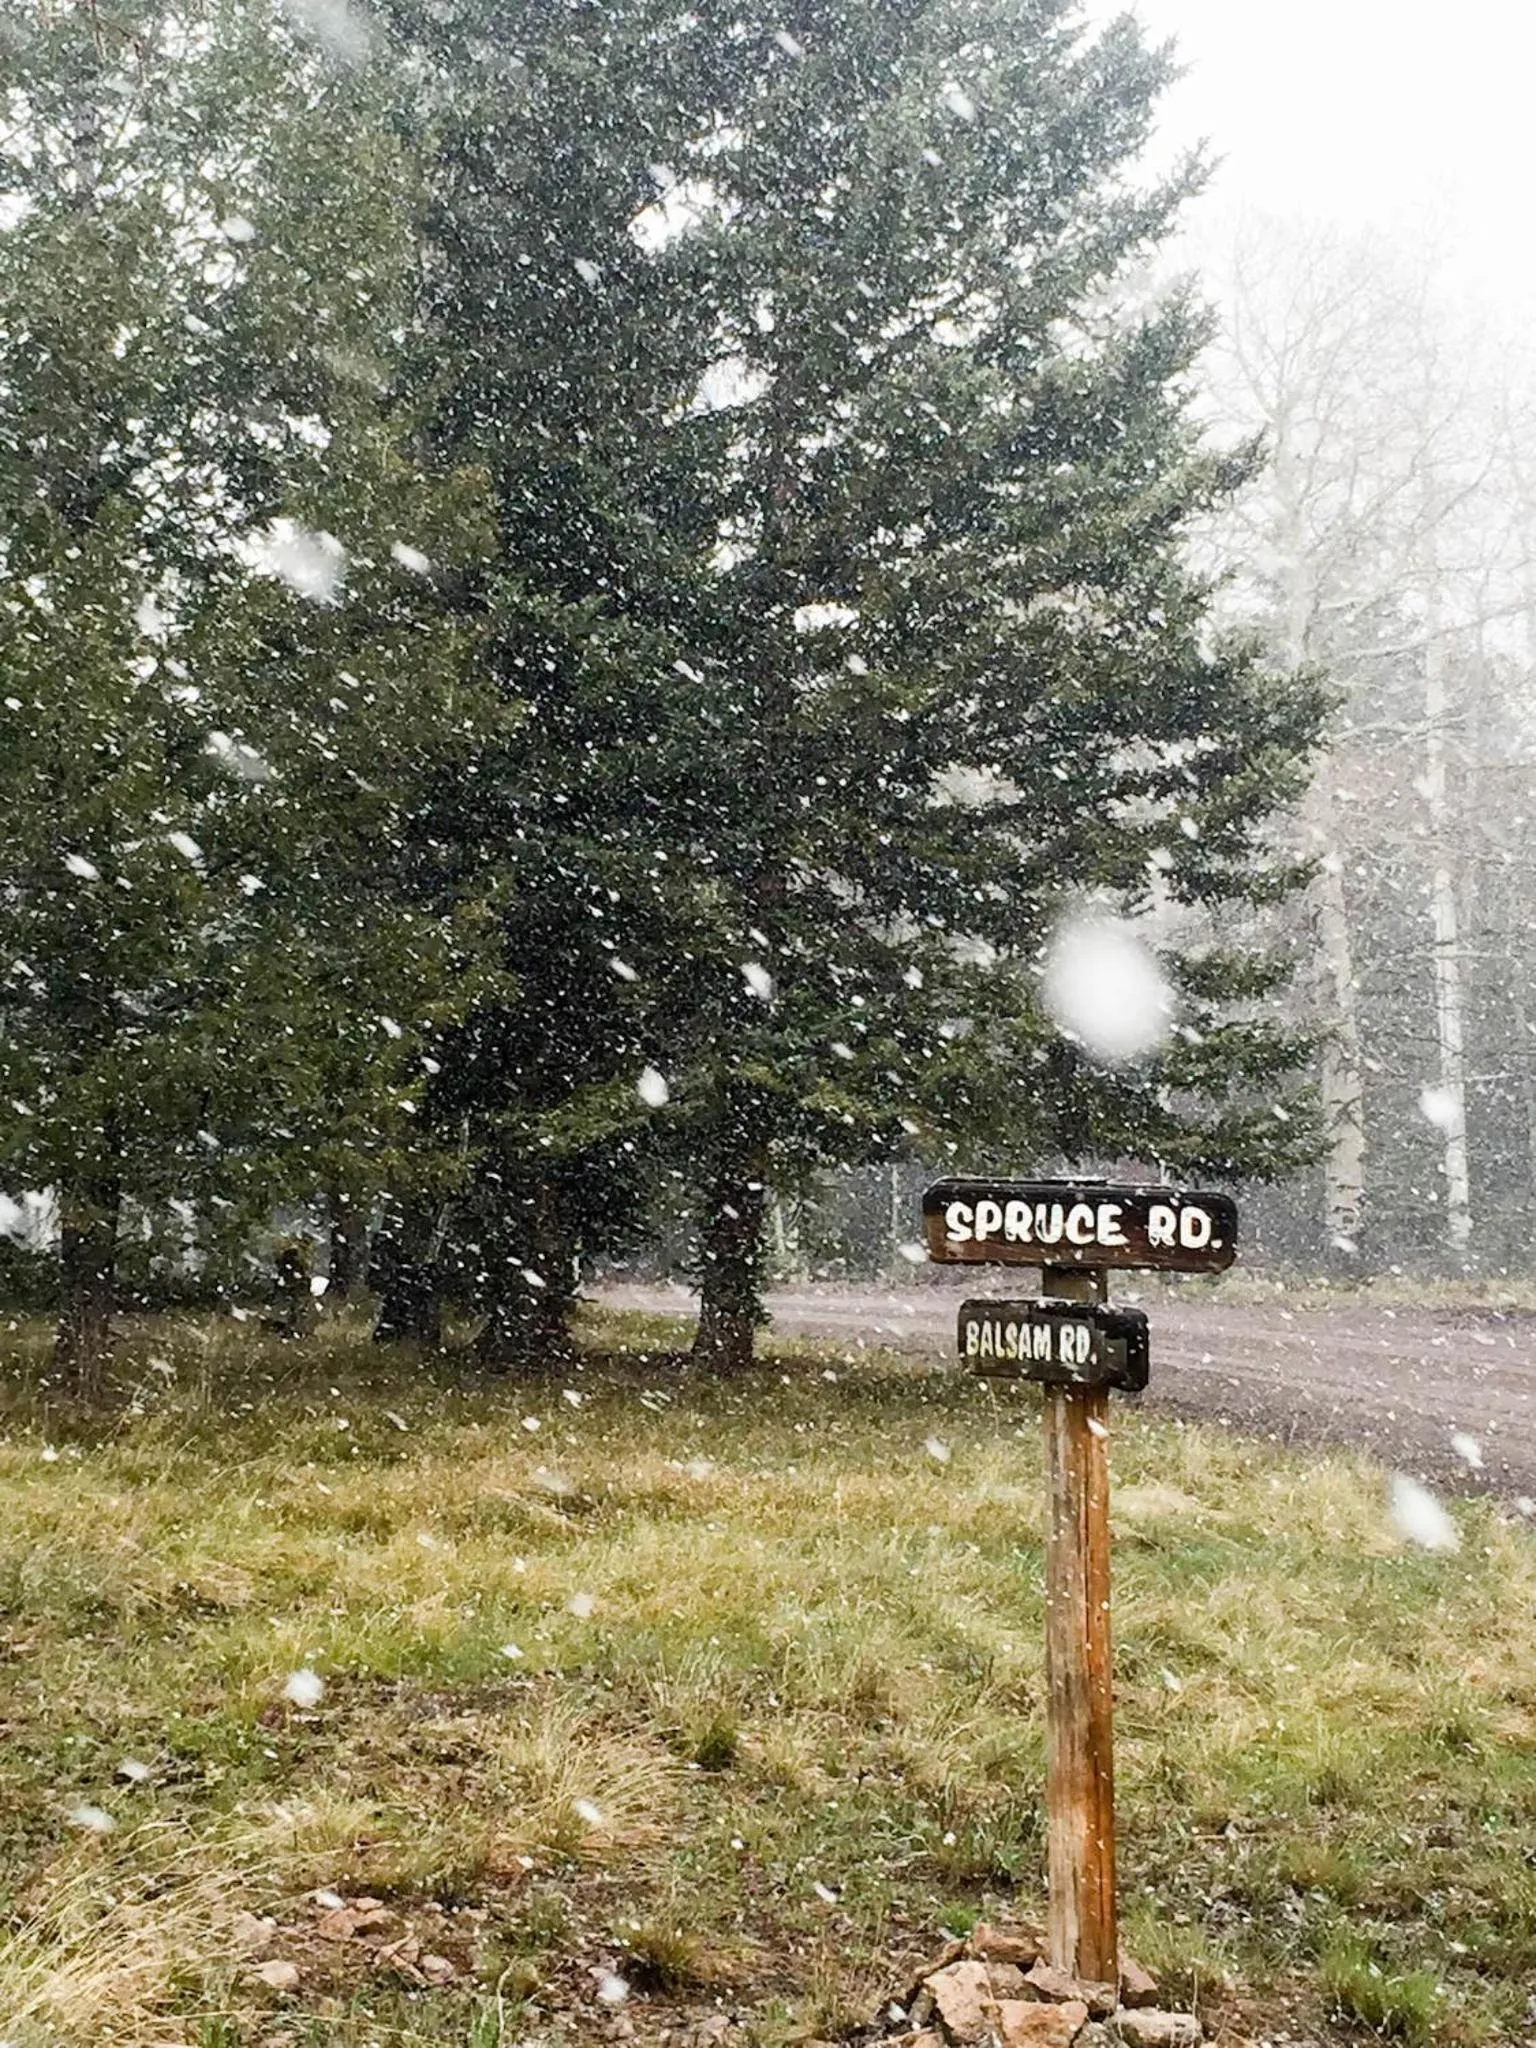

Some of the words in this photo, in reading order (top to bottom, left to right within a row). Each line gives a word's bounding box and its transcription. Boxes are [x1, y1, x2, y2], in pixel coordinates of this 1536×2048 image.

[945, 1200, 1130, 1246] SPRUCE
[1149, 1205, 1222, 1249] RD.
[966, 1320, 1052, 1360] BALSAM
[1059, 1323, 1098, 1364] RD.
